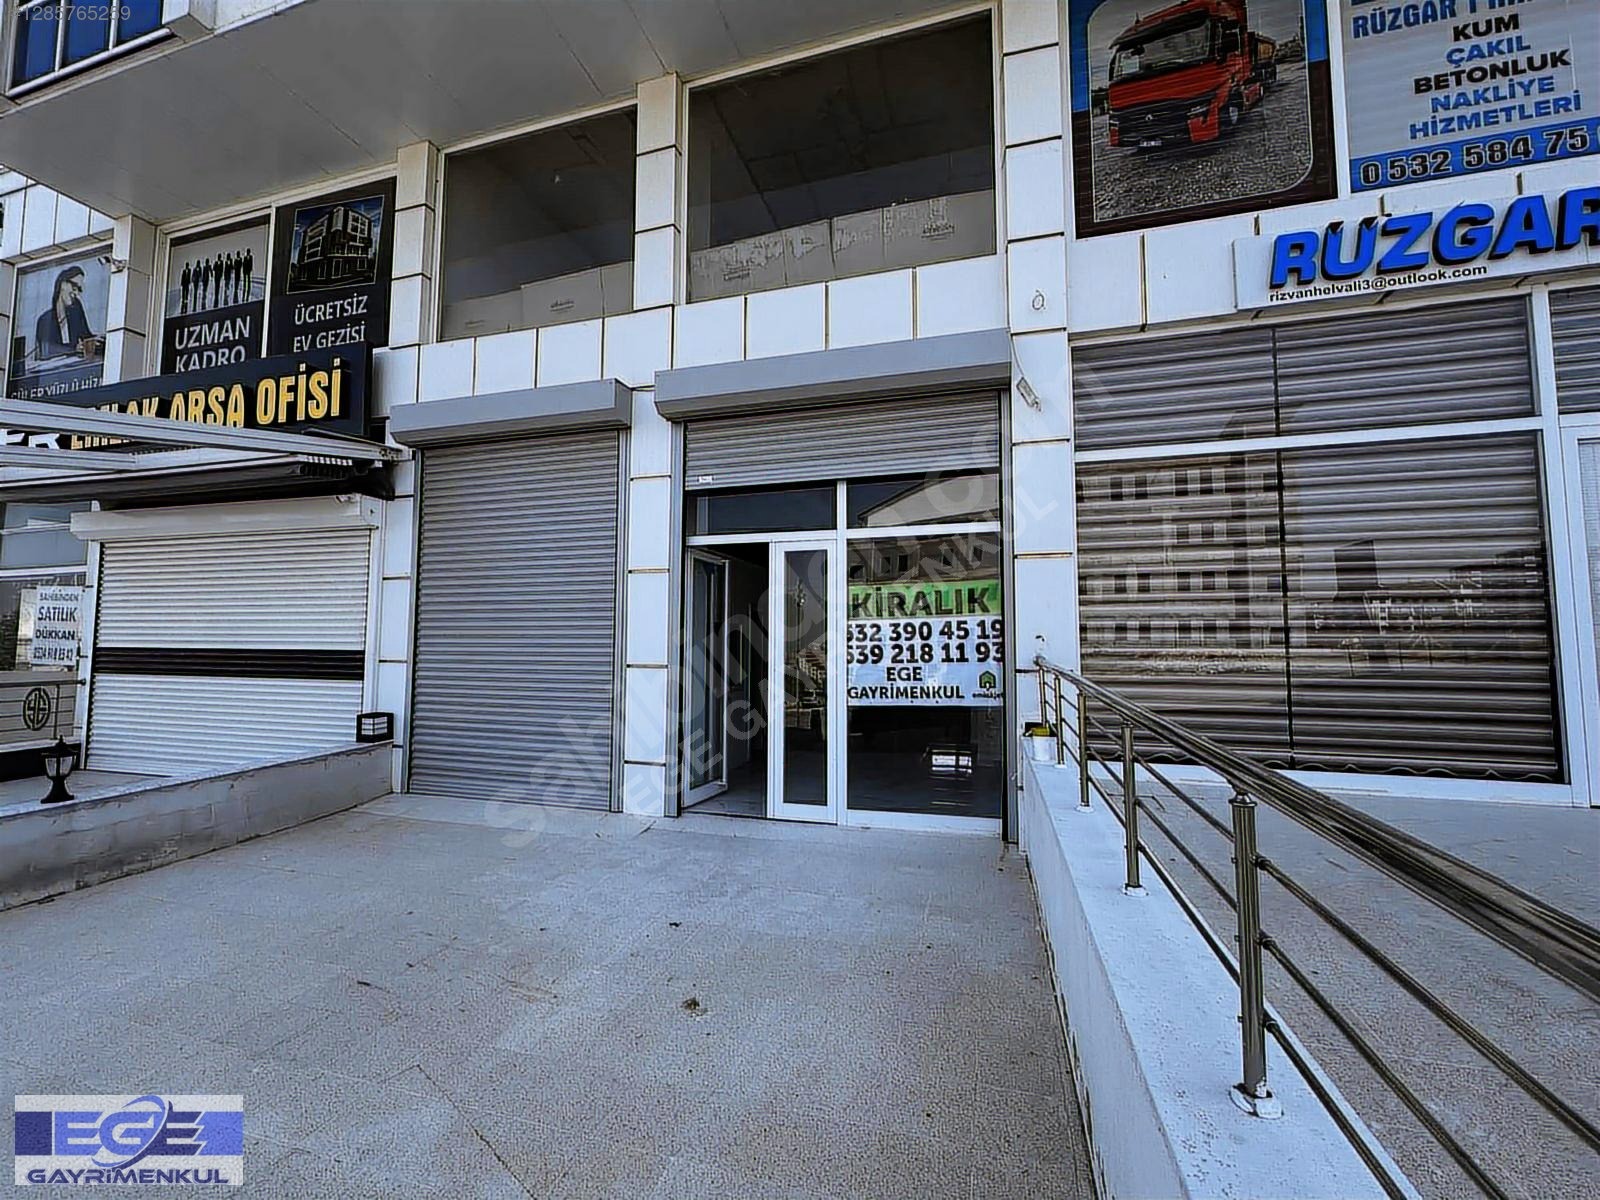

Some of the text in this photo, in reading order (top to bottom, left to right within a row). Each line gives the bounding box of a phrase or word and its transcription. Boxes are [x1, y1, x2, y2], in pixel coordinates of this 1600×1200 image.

[1352, 0, 1457, 39] RÜZGAR
[1452, 13, 1520, 42] KUM
[1446, 35, 1531, 68] ÇAKIL
[1413, 48, 1571, 94] BETONLUK
[1431, 75, 1555, 113] NAKLİYE
[1409, 90, 1581, 139] HİZMETLERİ
[1360, 161, 1381, 186] 0
[1388, 149, 1452, 181] 532
[1463, 134, 1534, 168] 584
[1543, 126, 1590, 156] 75
[1268, 264, 1488, 303] rizvanhelvali3@outlook.com
[294, 292, 369, 326] ÜCRETSİZ
[175, 315, 250, 350] UZMAN
[293, 321, 366, 353] EV GEZİSİ
[175, 345, 246, 374] KADRO
[169, 383, 245, 429] ARSA
[256, 357, 342, 425] OFİSİ
[38, 606, 78, 622] SATILIK
[852, 586, 991, 618] KİRALIK
[35, 626, 76, 641] DÜKKAN
[888, 621, 932, 641] 390
[939, 619, 970, 640] 45
[976, 618, 1002, 640] 19
[891, 643, 934, 664] 218
[941, 642, 970, 663] 11
[975, 641, 1003, 663] 93
[886, 666, 923, 682] EGE
[847, 683, 965, 699] GAYRİMENKUL
